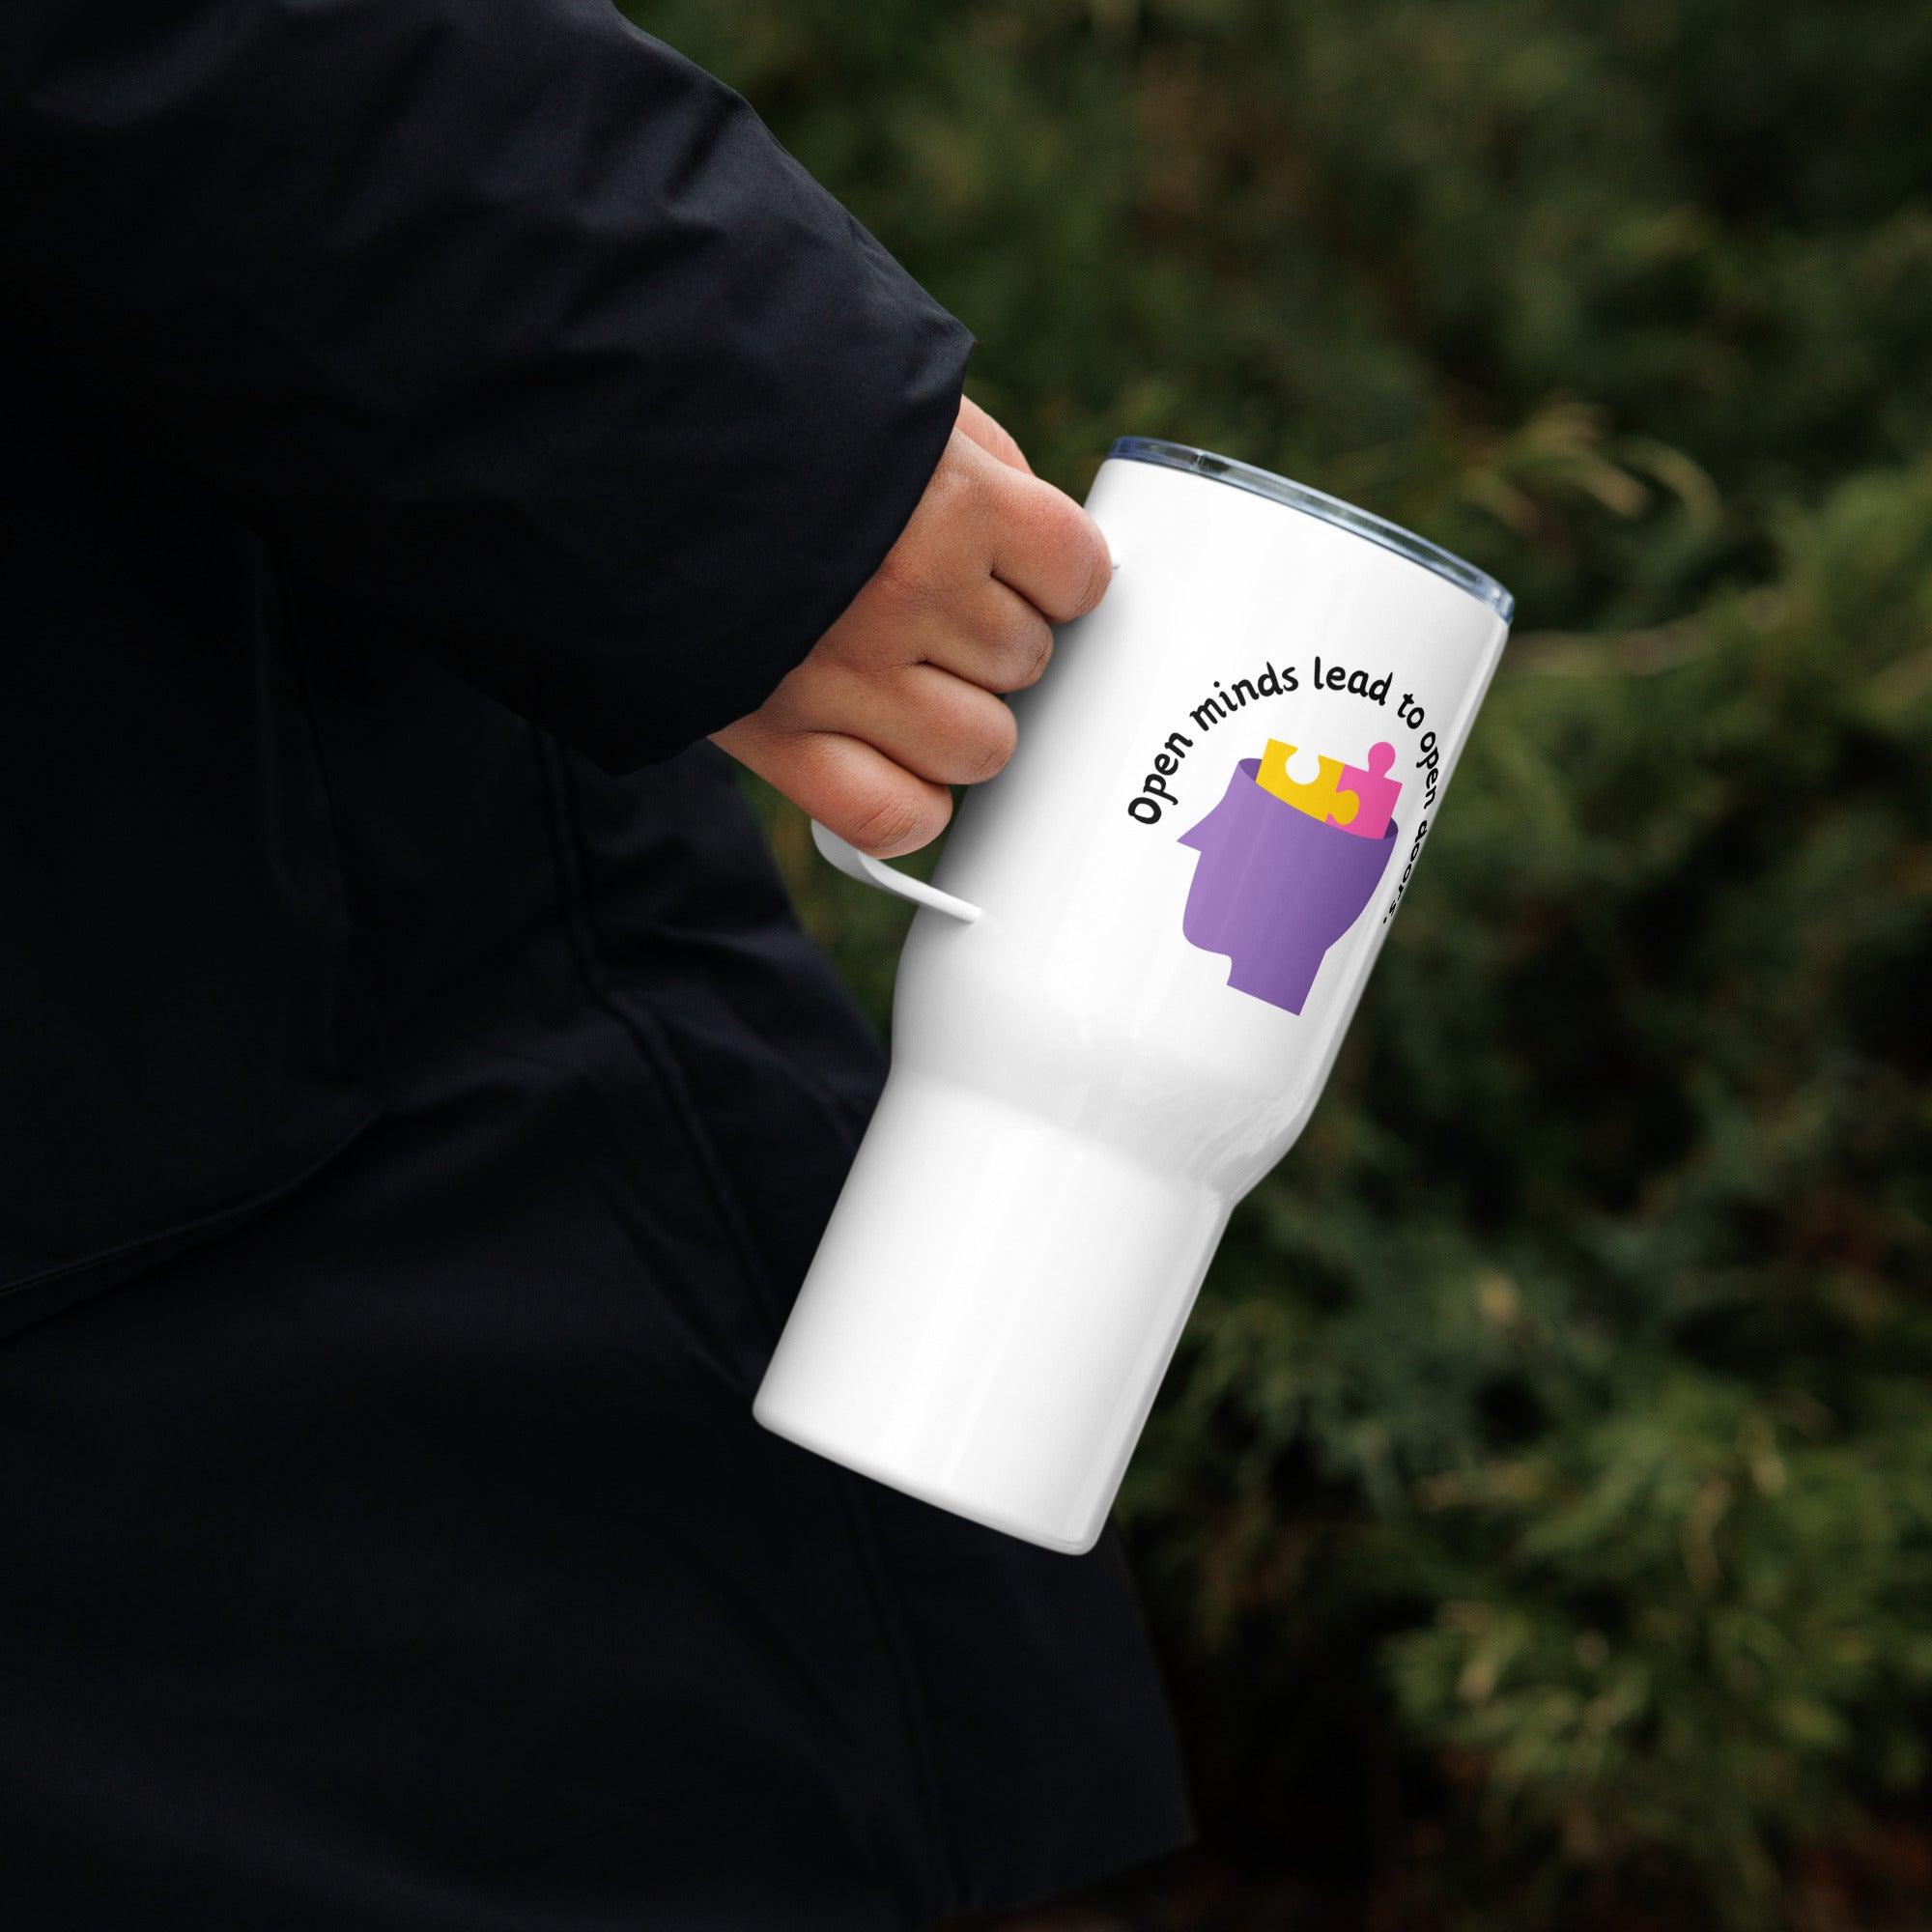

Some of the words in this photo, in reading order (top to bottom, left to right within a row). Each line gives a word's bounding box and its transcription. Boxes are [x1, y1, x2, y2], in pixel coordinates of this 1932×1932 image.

[1127, 731, 1194, 825] Open
[1189, 661, 1299, 731] minds
[1313, 656, 1394, 706] lead
[1397, 693, 1425, 729] to
[1415, 730, 1441, 810] open
